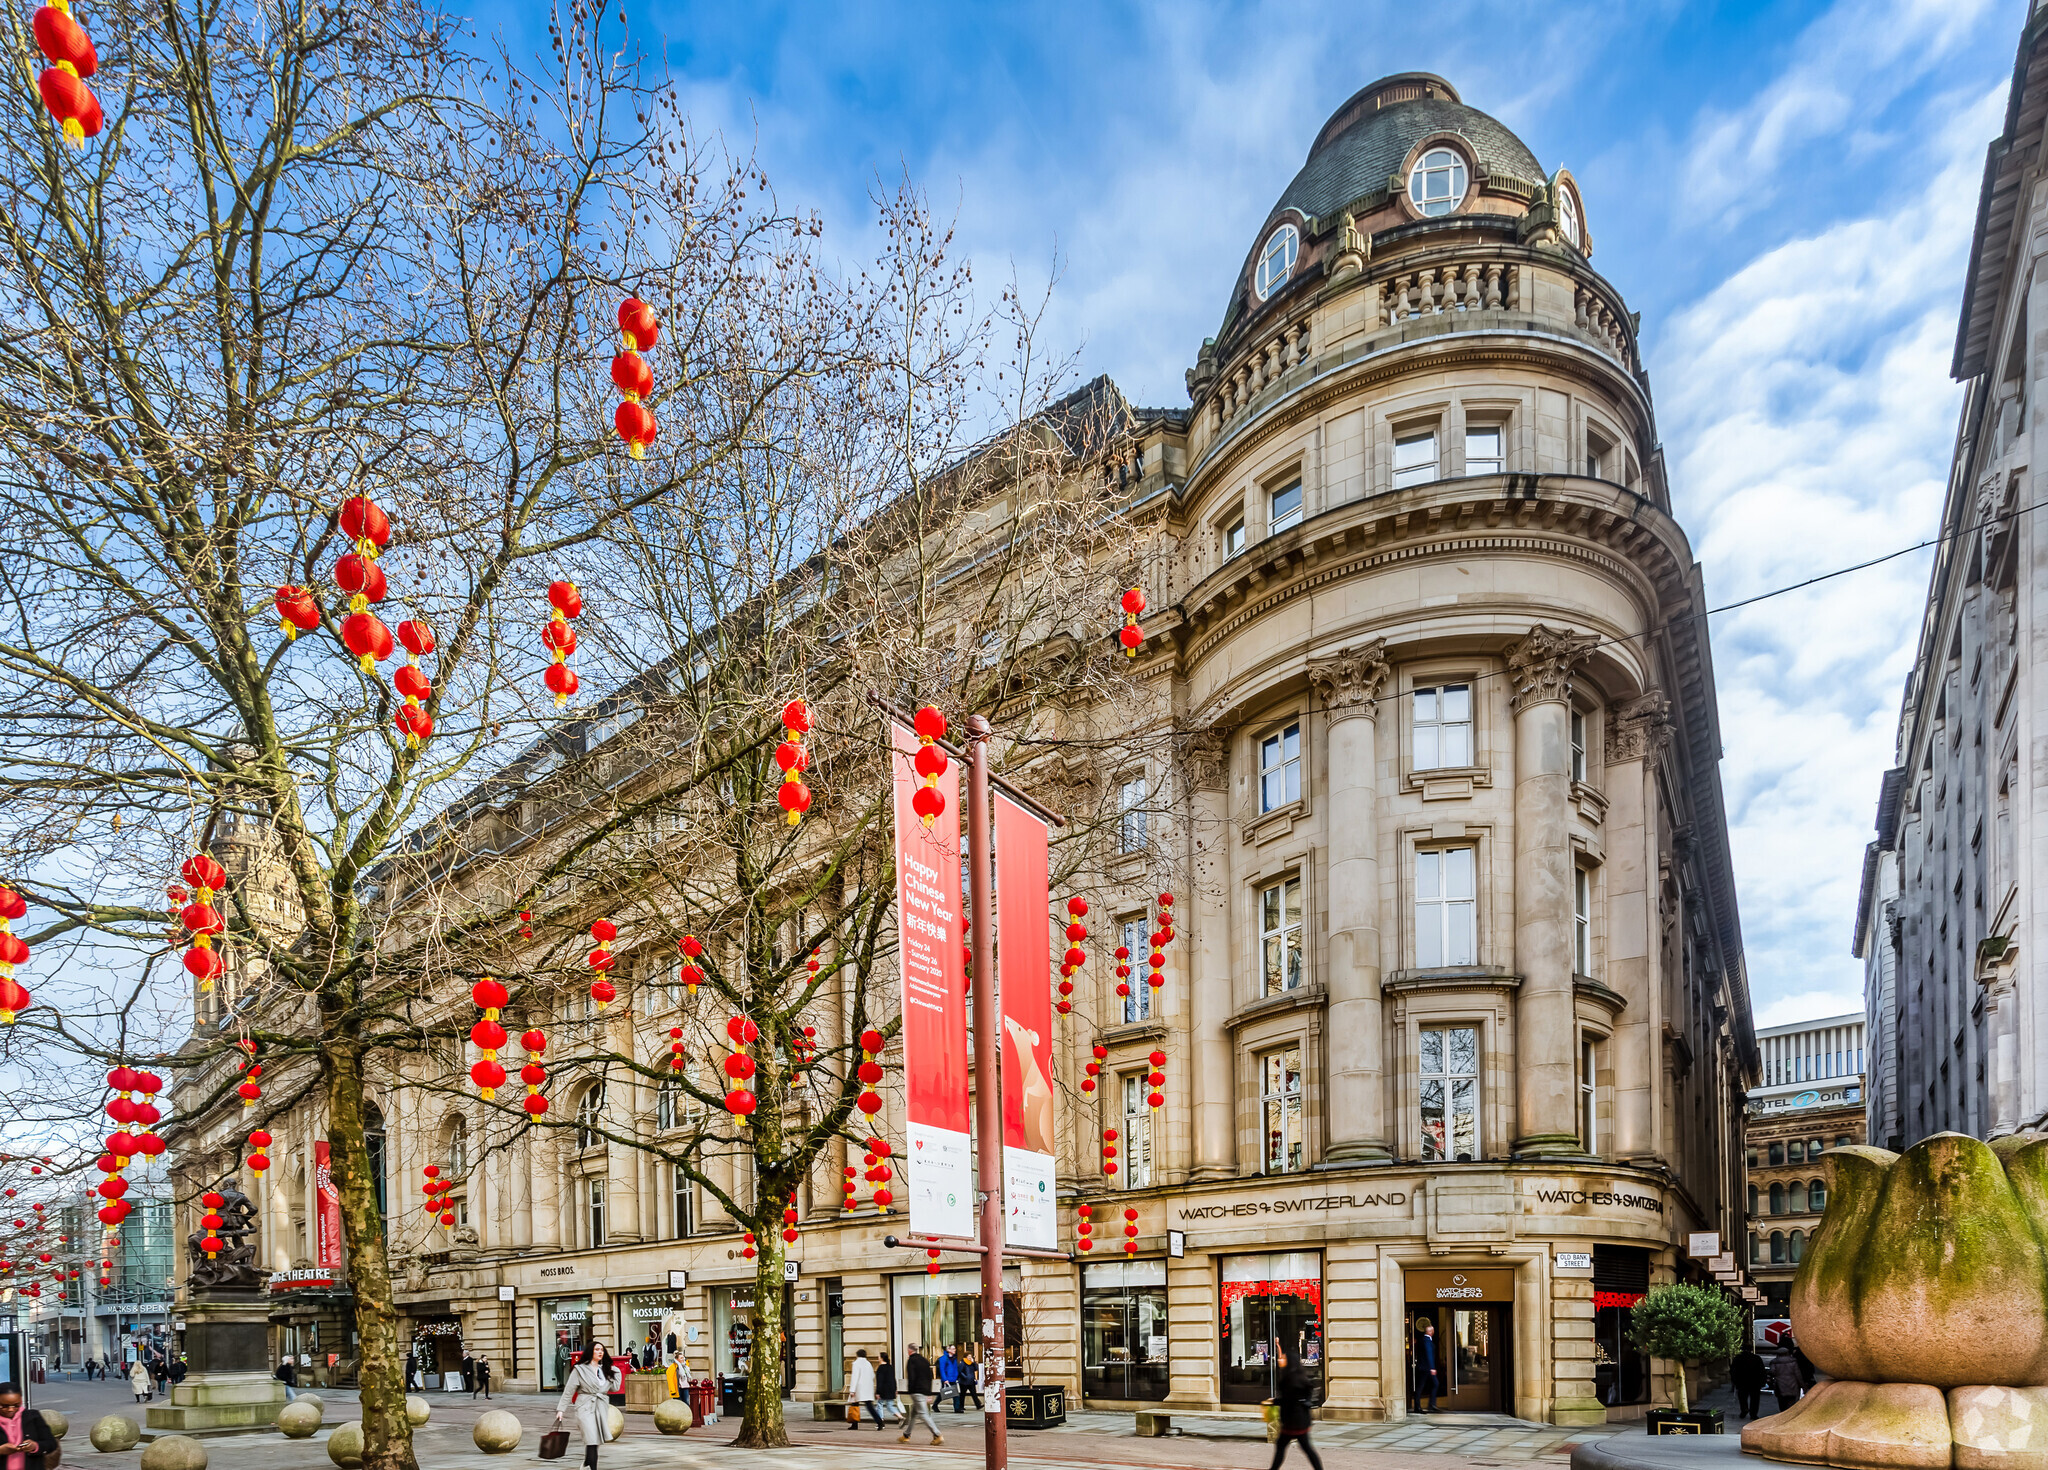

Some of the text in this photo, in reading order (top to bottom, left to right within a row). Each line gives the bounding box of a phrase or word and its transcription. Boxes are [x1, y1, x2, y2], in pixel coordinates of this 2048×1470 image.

[904, 852, 938, 884] Happy
[905, 873, 945, 902] Chinese
[905, 889, 953, 922] New Year
[906, 912, 946, 942] 新年快樂
[908, 937, 930, 952] Friday 24
[908, 959, 942, 977] January 2020
[931, 957, 938, 965] 26
[1537, 1190, 1612, 1205] WATCHES
[1179, 1203, 1256, 1220] WATCHES
[1274, 1192, 1406, 1213] SWITZERLAND
[288, 1268, 330, 1280] THEATRE
[541, 1266, 575, 1277] MOSS BROS.
[551, 1312, 587, 1321] MOSS BROS.
[633, 1307, 652, 1318] MOSS
